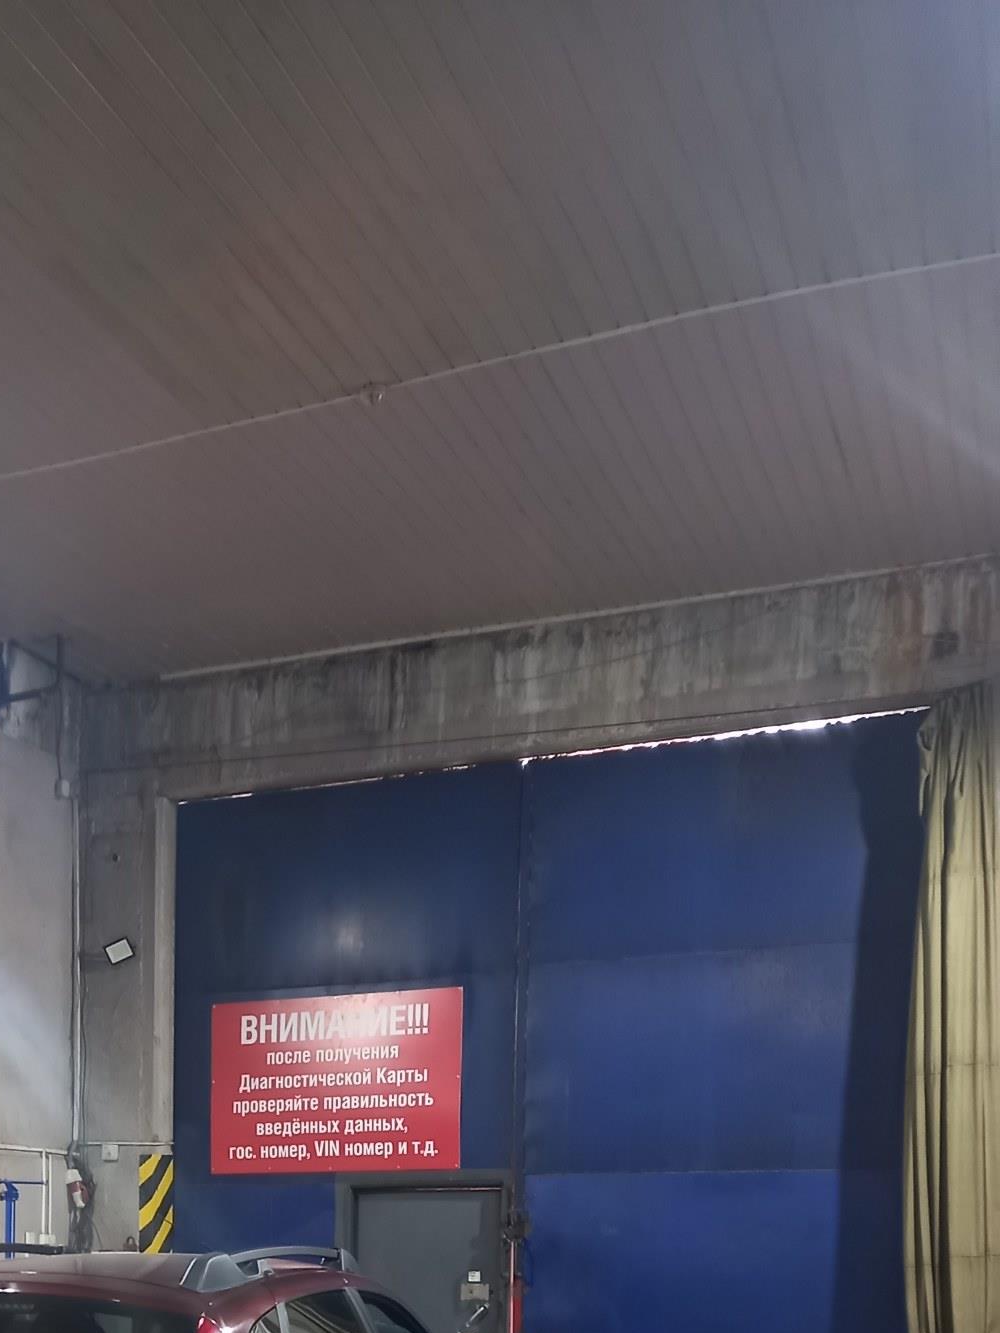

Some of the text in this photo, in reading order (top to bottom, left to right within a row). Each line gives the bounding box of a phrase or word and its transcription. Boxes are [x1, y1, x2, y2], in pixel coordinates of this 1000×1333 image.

[240, 1003, 429, 1045] ВНИМАНИЕ!!!
[266, 1045, 399, 1065] после получения
[238, 1066, 428, 1093] Диагностической Карты
[232, 1092, 434, 1115] проверяйте правильность
[256, 1117, 408, 1137] введённых данных,
[229, 1139, 439, 1160] гос. номер, VIN номер и т.д.
